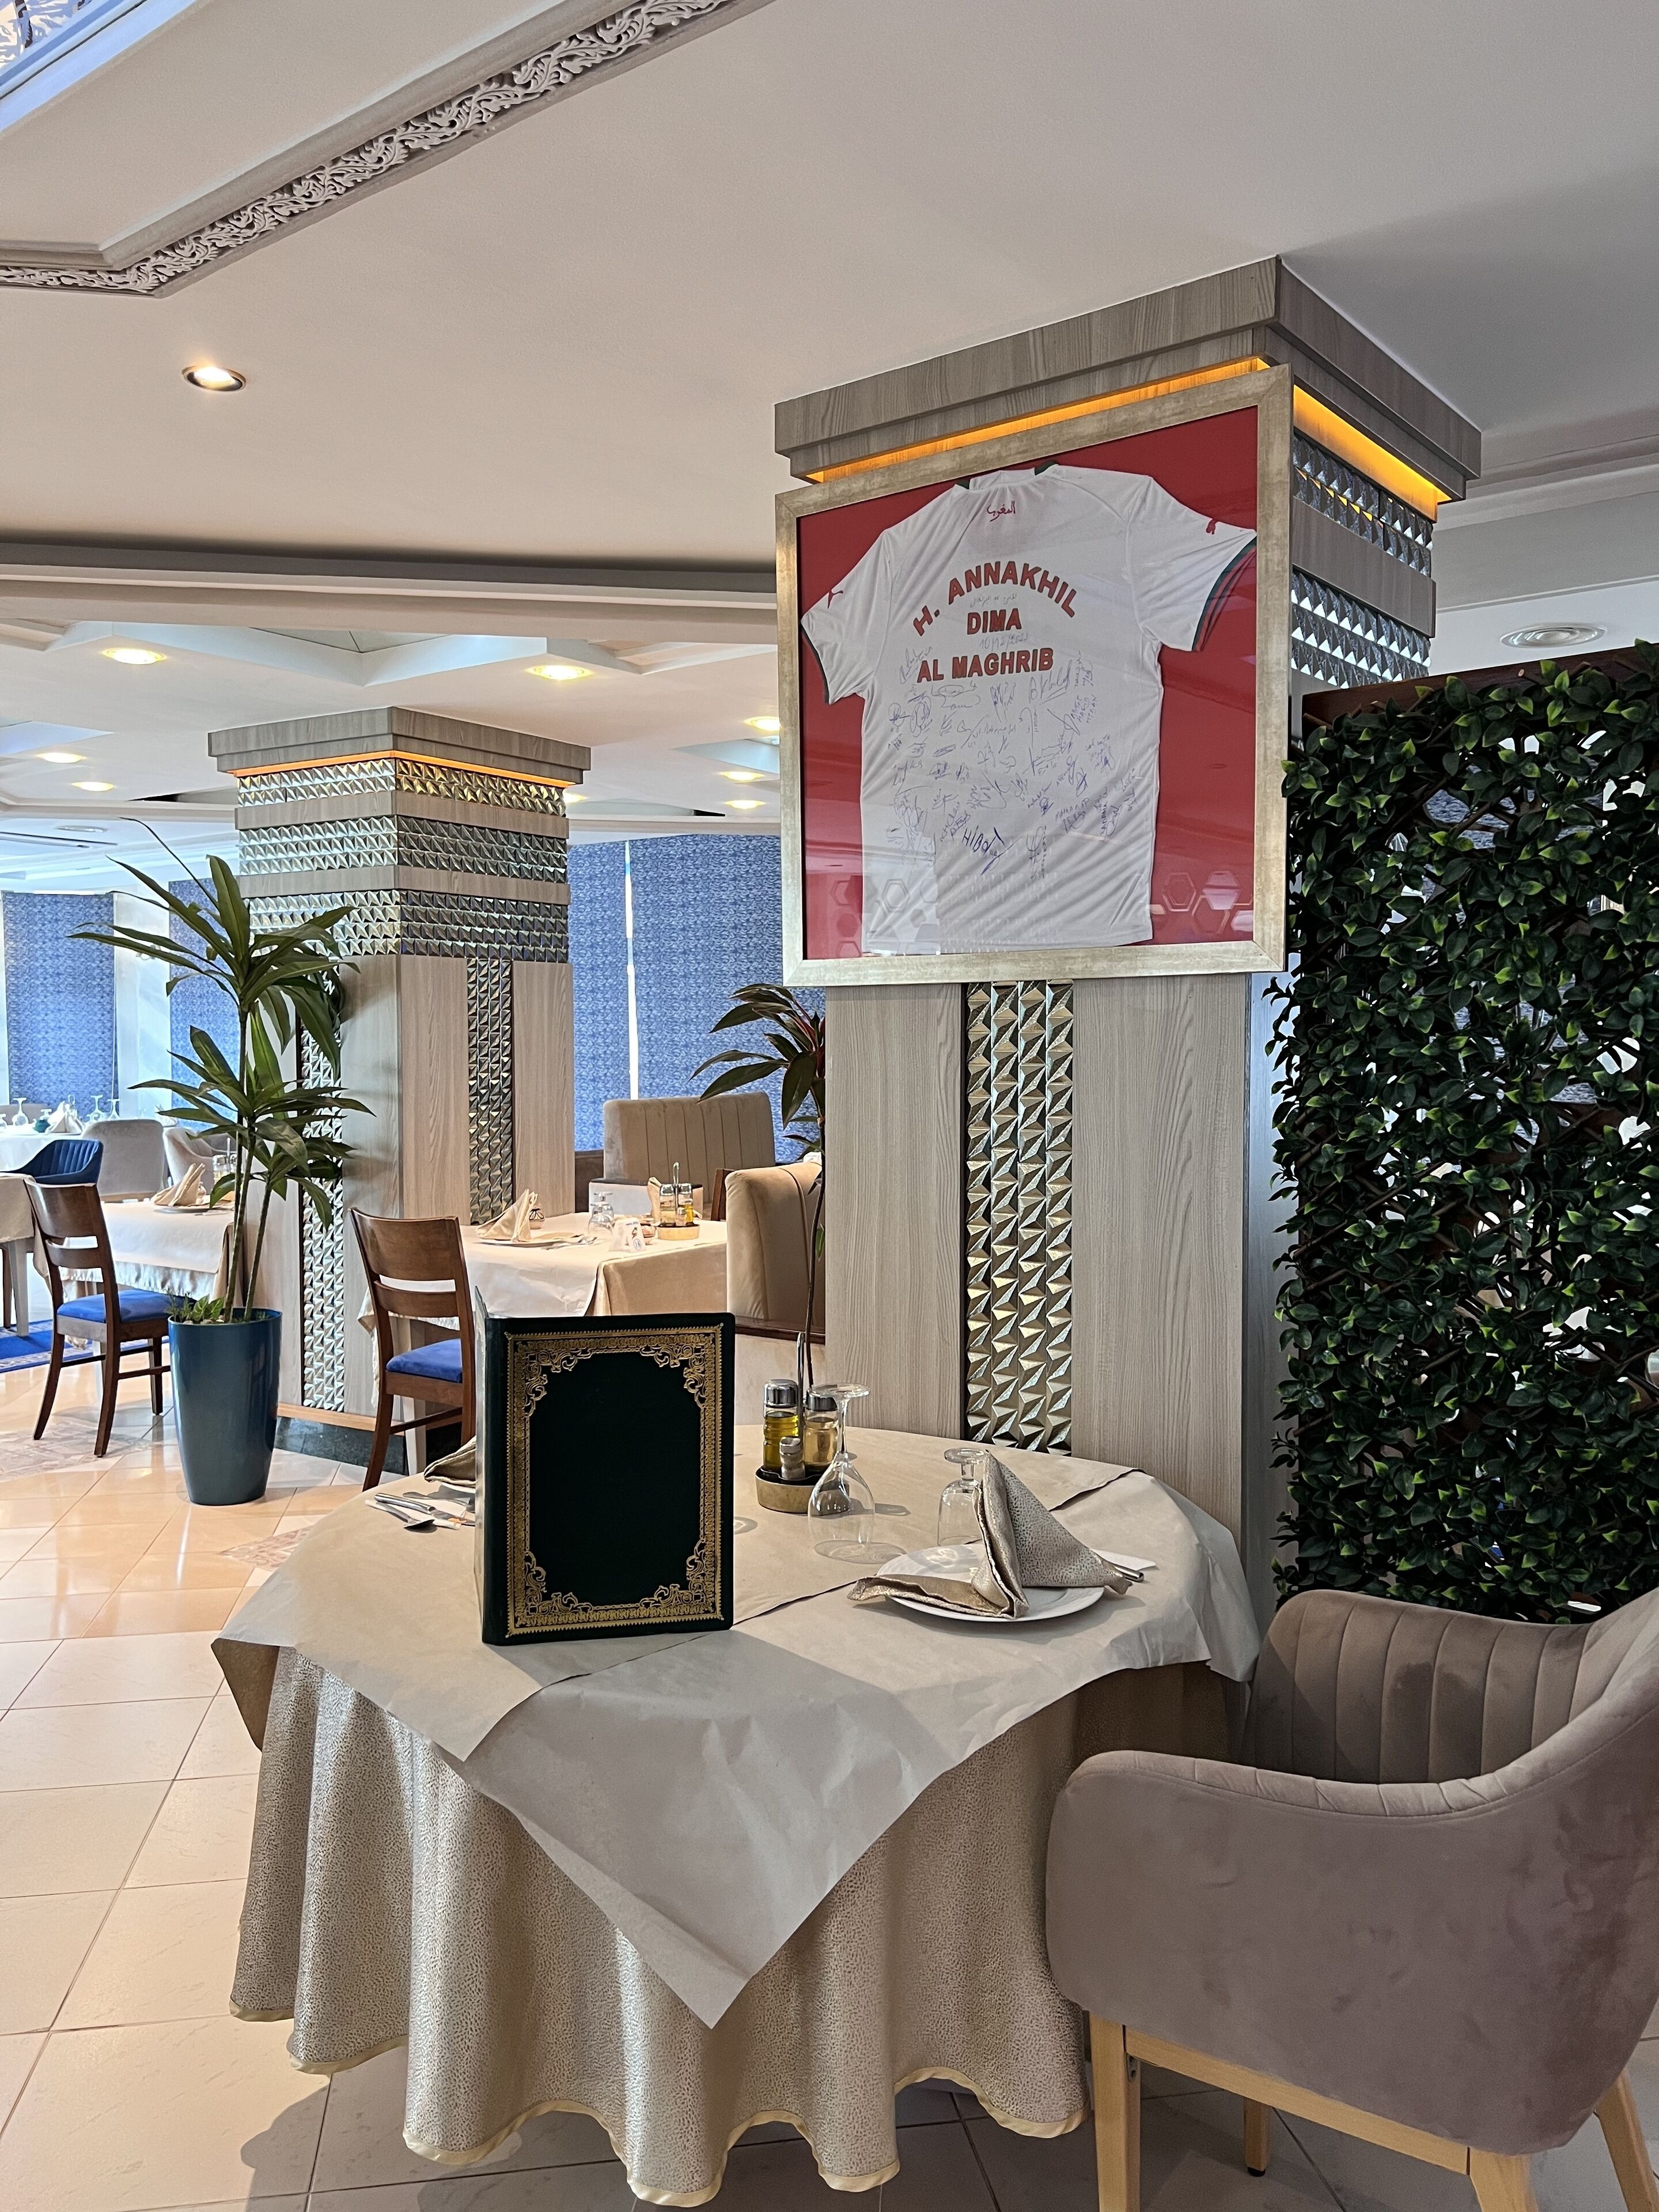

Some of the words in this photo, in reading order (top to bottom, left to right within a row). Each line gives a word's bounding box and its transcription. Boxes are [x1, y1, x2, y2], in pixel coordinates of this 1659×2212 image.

[986, 501, 1016, 522] المغرب
[913, 605, 940, 637] H.
[948, 560, 1077, 618] ANNAKHIL
[967, 608, 1022, 635] DIMA
[916, 659, 944, 683] AL
[952, 647, 1054, 679] MAGHRIB
